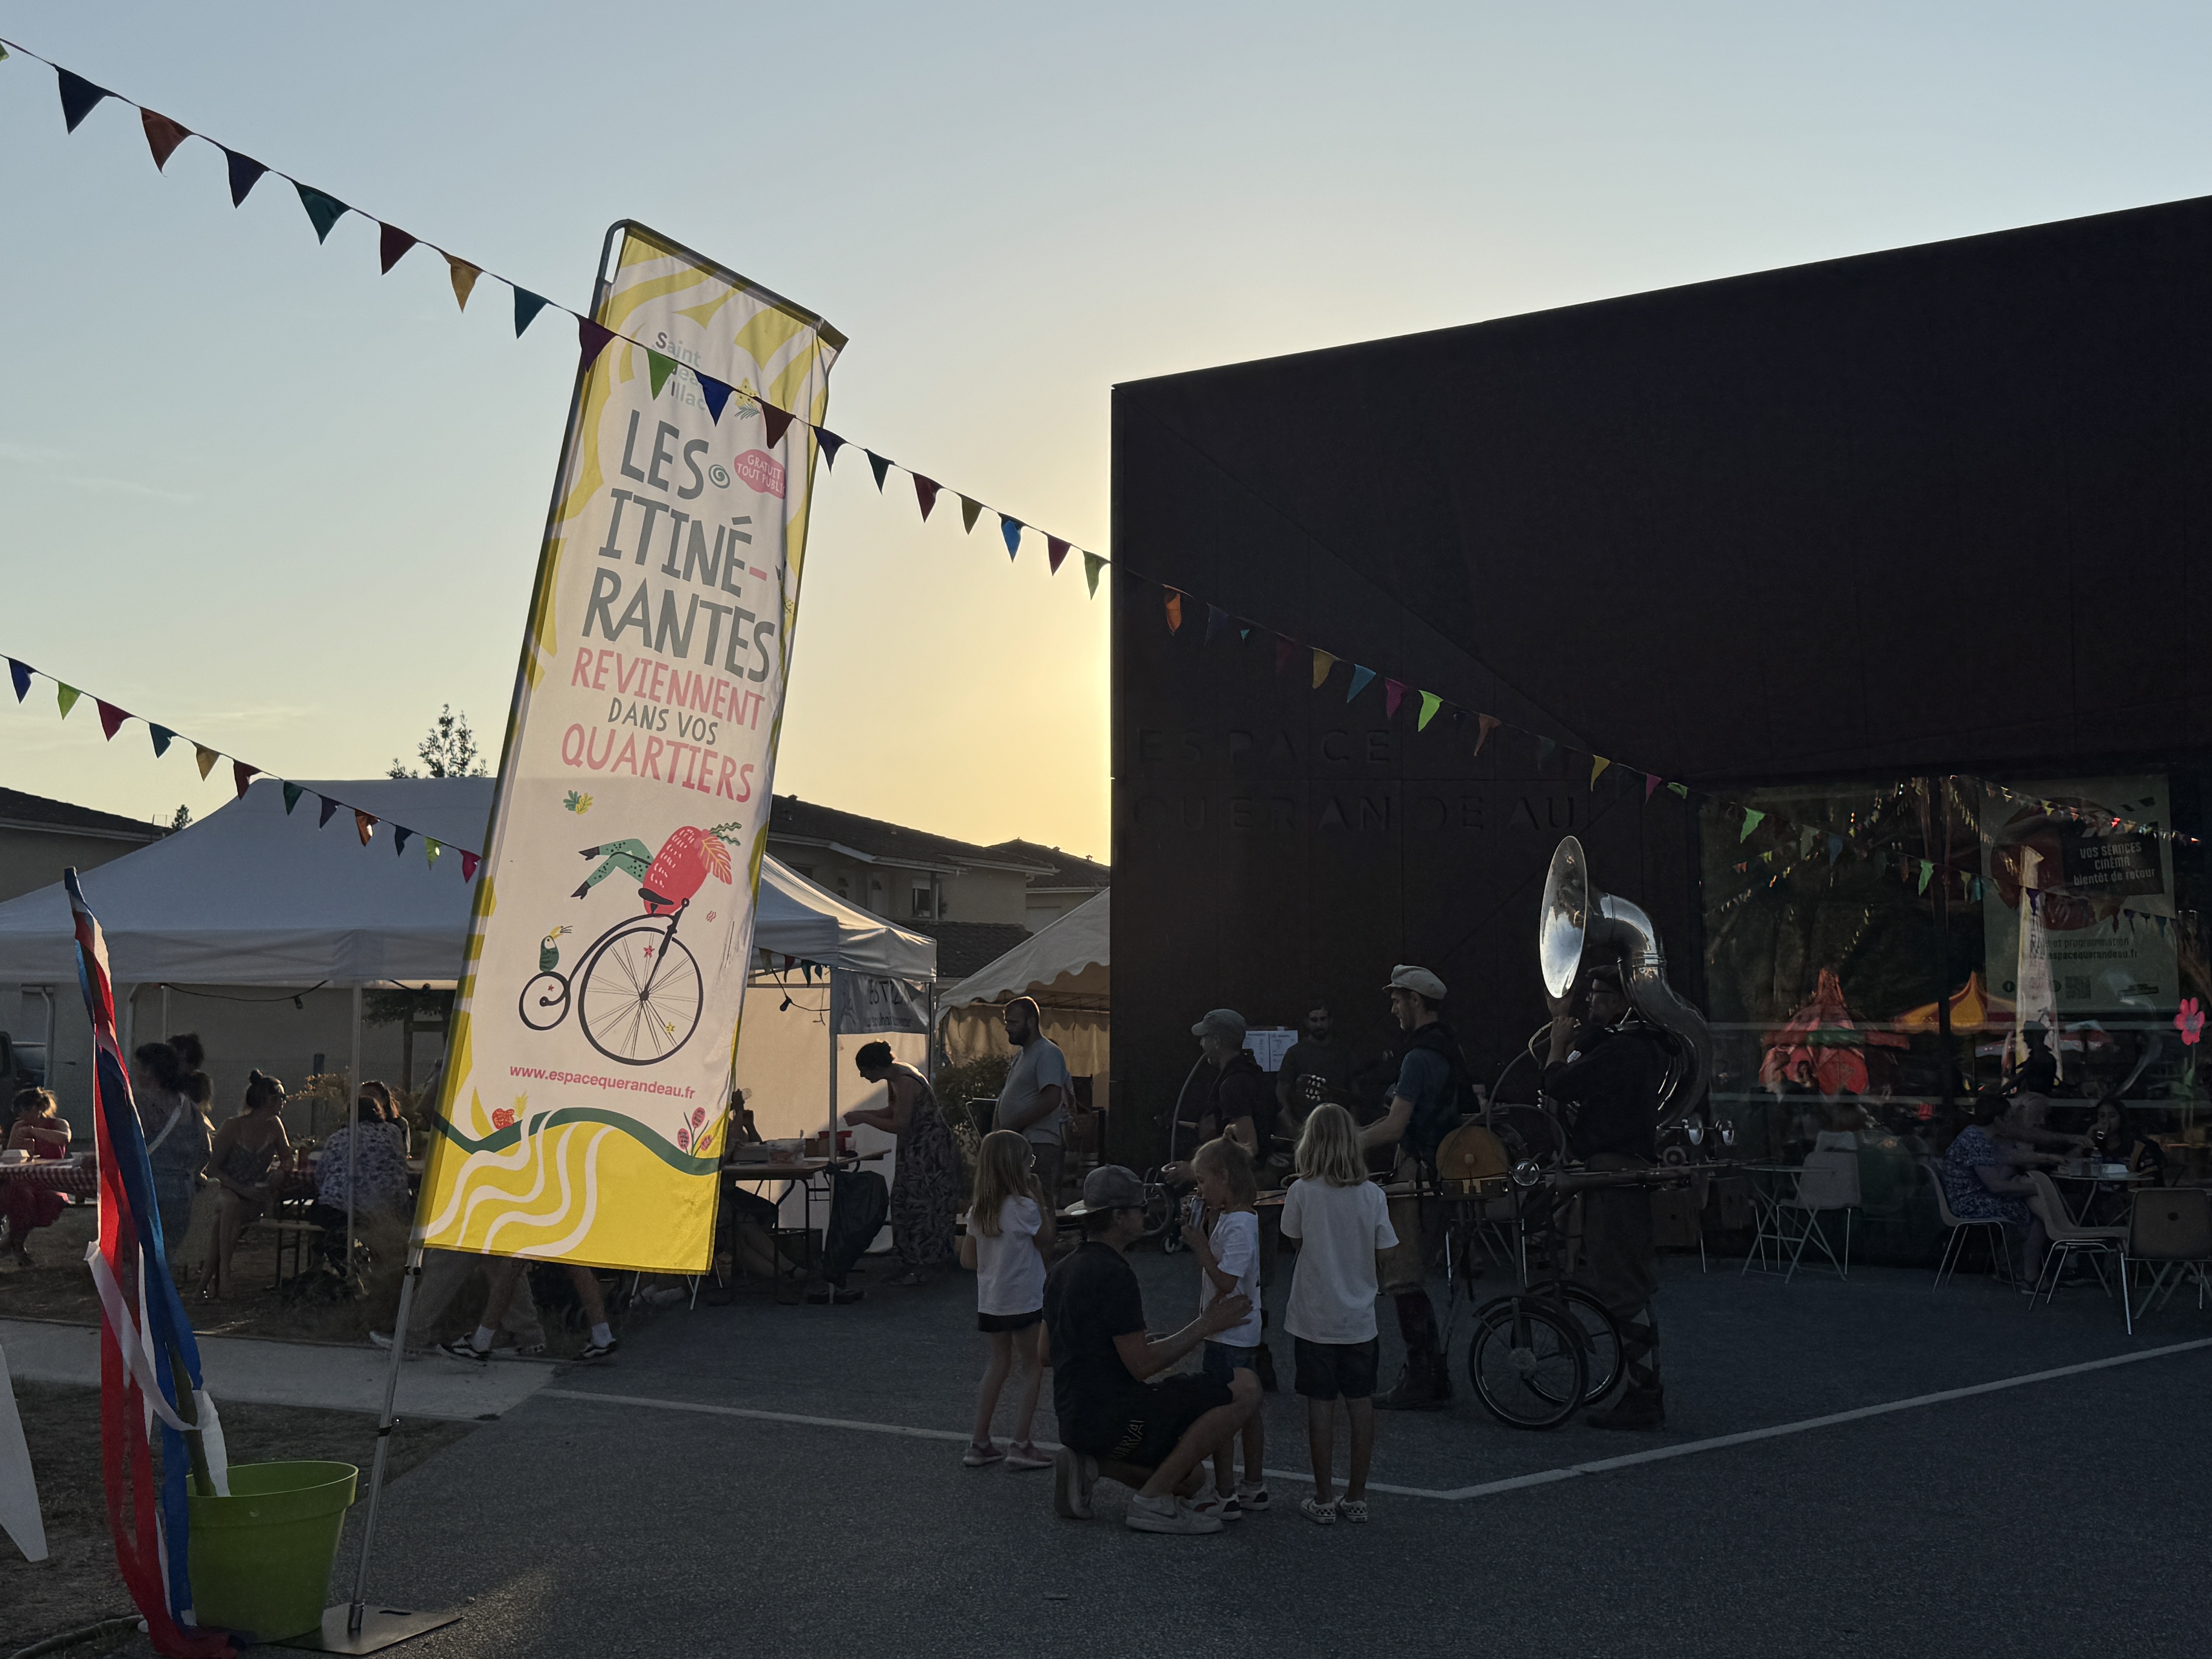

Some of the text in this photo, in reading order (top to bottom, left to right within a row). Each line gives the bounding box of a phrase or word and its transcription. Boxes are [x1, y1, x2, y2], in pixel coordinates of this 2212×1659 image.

[655, 331, 701, 368] Saint
[620, 409, 709, 500] LES
[737, 463, 761, 481] TOUT
[748, 455, 782, 480] GRATUIT
[598, 488, 767, 598] ITINÉ-
[582, 567, 775, 683] RANTES
[571, 647, 765, 731] REVIENNENT
[608, 697, 718, 745] DANS VOS
[562, 723, 754, 803] QUARTIERS
[1138, 728, 1391, 763] ESPACE
[1133, 794, 1574, 831] QUERANDEAU
[2079, 847, 2099, 859] VOS
[2094, 855, 2131, 871] CINÉMA
[2073, 868, 2156, 886] bientôt de retour
[510, 1066, 696, 1099] www.espacequerandeau.fr
